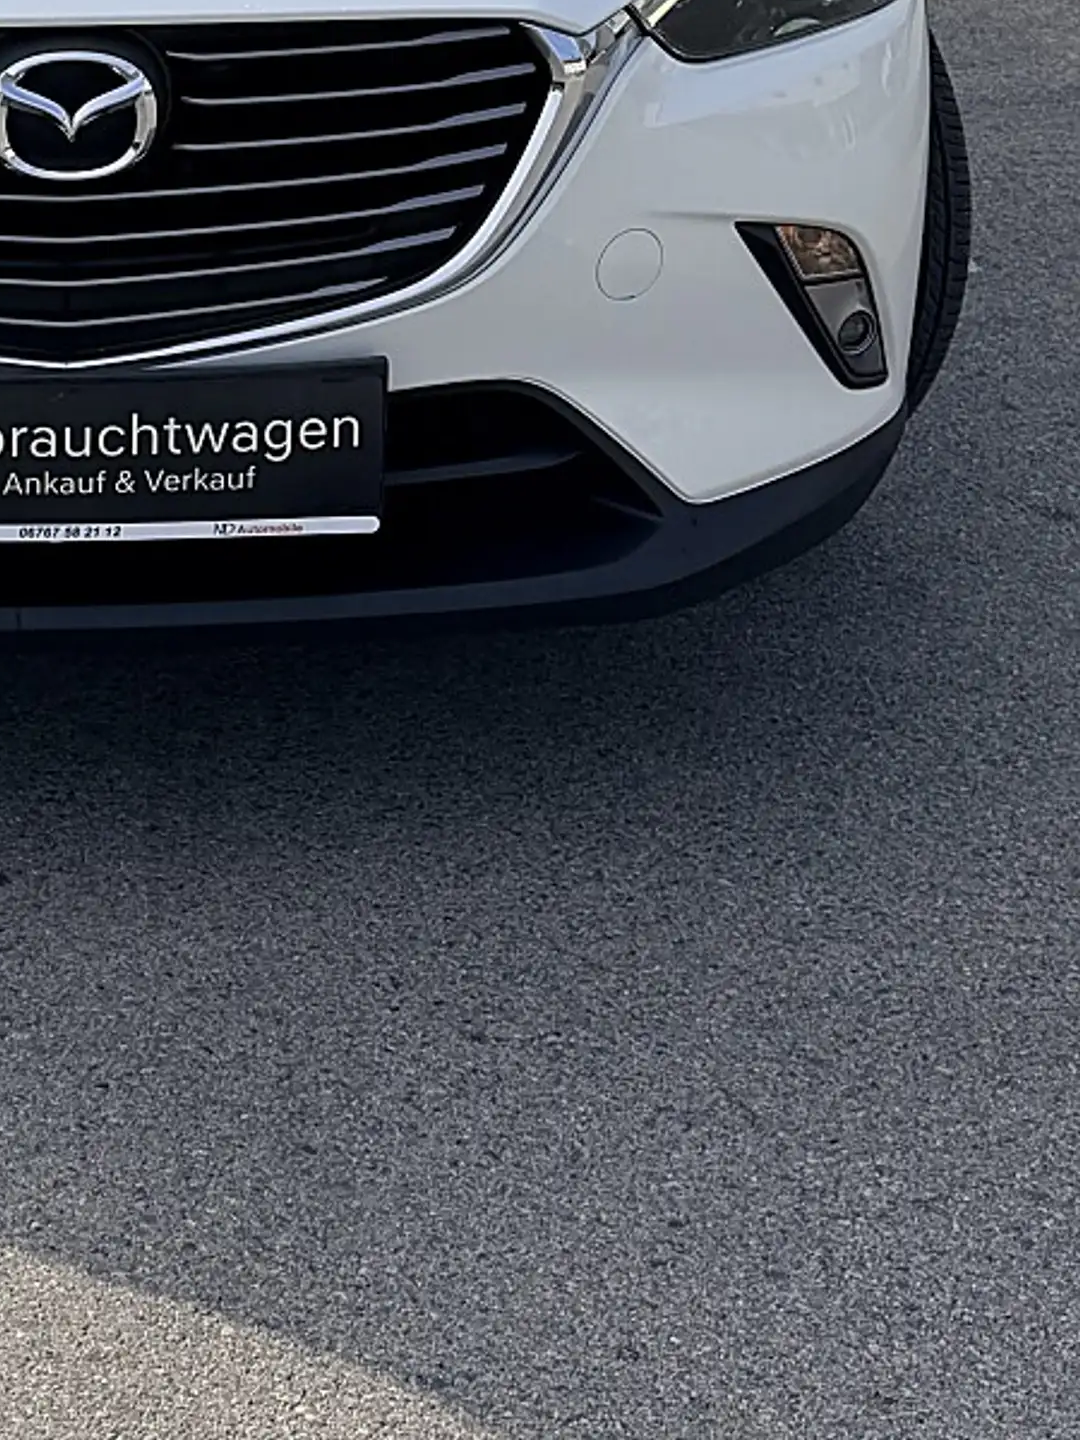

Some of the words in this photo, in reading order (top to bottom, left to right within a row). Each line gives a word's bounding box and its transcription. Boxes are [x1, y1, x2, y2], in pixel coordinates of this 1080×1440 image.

[2, 469, 108, 496] Ankauf
[115, 470, 136, 494] &
[143, 464, 258, 492] Verkauf
[83, 526, 100, 538] 21
[104, 525, 122, 537] 12
